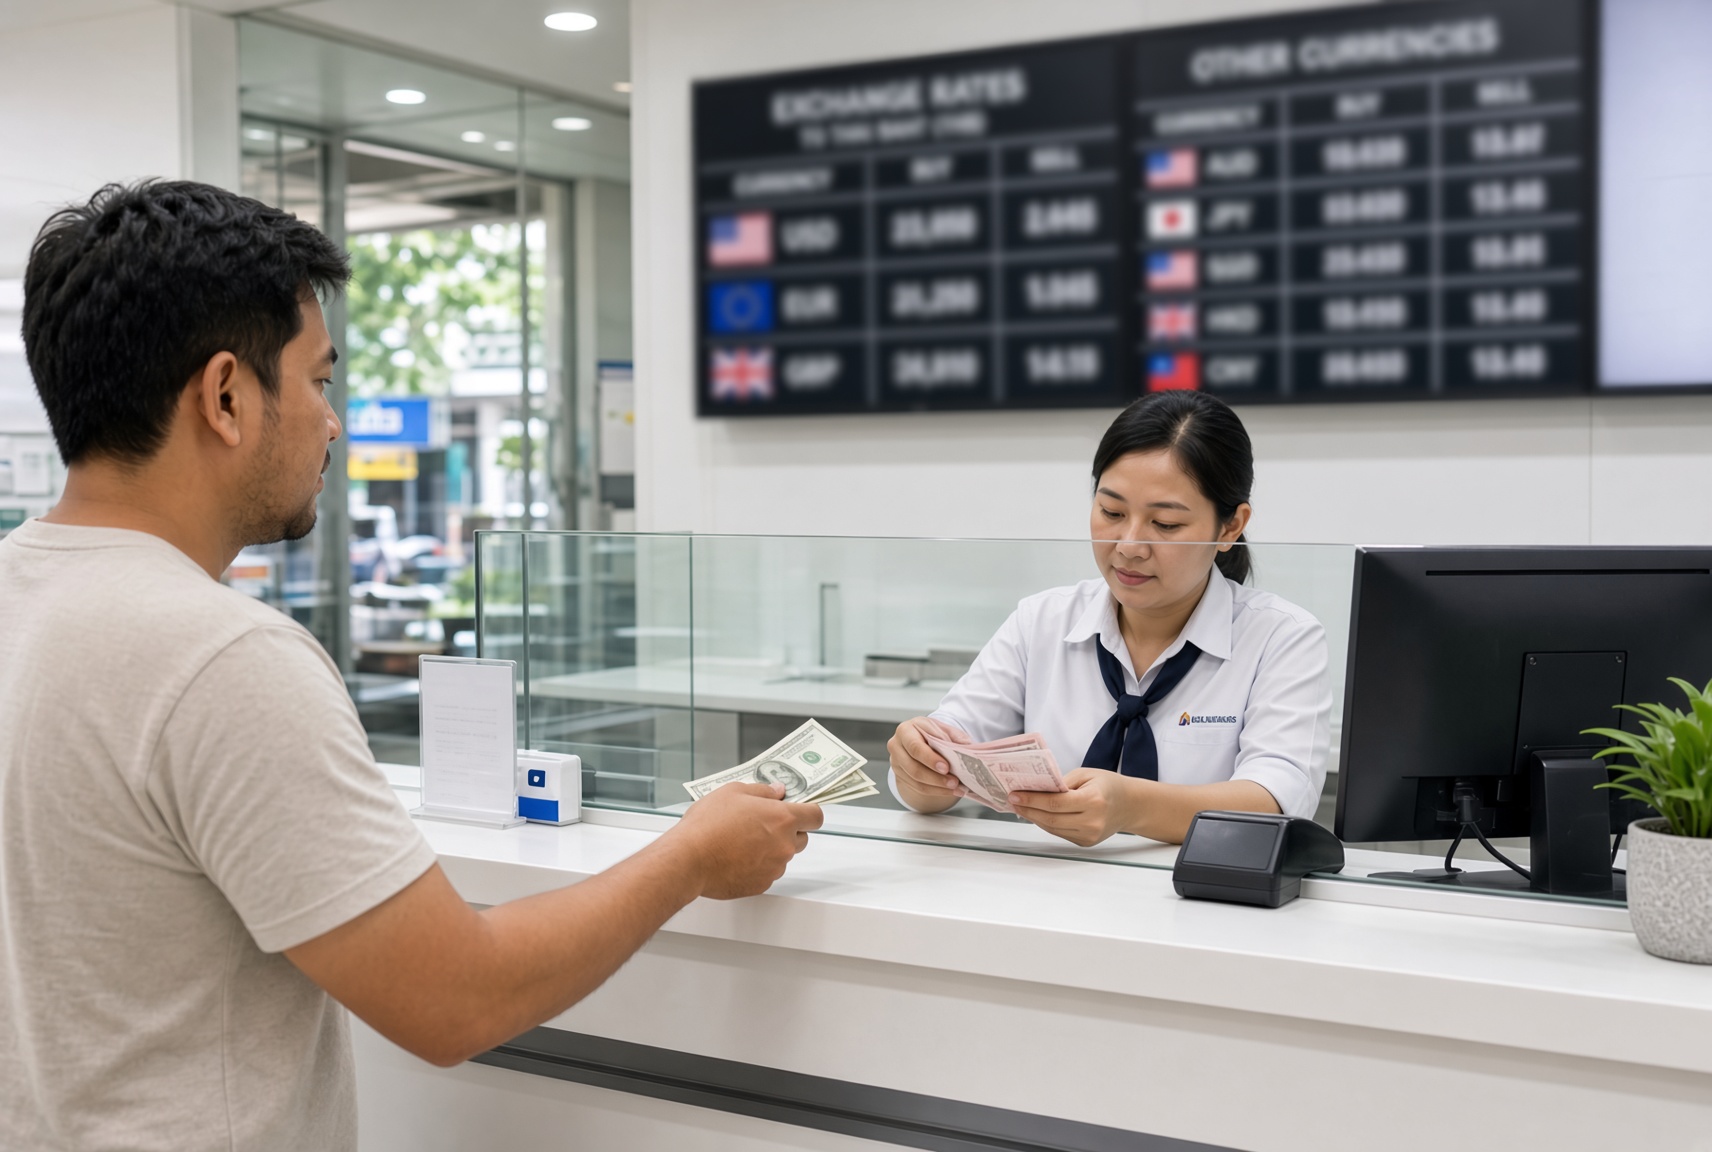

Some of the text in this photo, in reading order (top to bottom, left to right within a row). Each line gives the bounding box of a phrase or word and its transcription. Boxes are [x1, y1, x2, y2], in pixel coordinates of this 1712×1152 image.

[1191, 17, 1499, 81] OTHER CURRENCIES
[772, 68, 1026, 124] EXCHANGE RATES
[1337, 92, 1379, 118] BUY
[1478, 80, 1529, 105] SELL
[1157, 107, 1258, 133] CURRENCY
[911, 157, 950, 181] BUY
[1032, 147, 1077, 171] SELL
[1207, 150, 1256, 177] AUD
[735, 169, 830, 195] CURRENCY
[1209, 202, 1250, 228] JPY
[783, 219, 837, 251] USD
[783, 288, 836, 319] EUR
